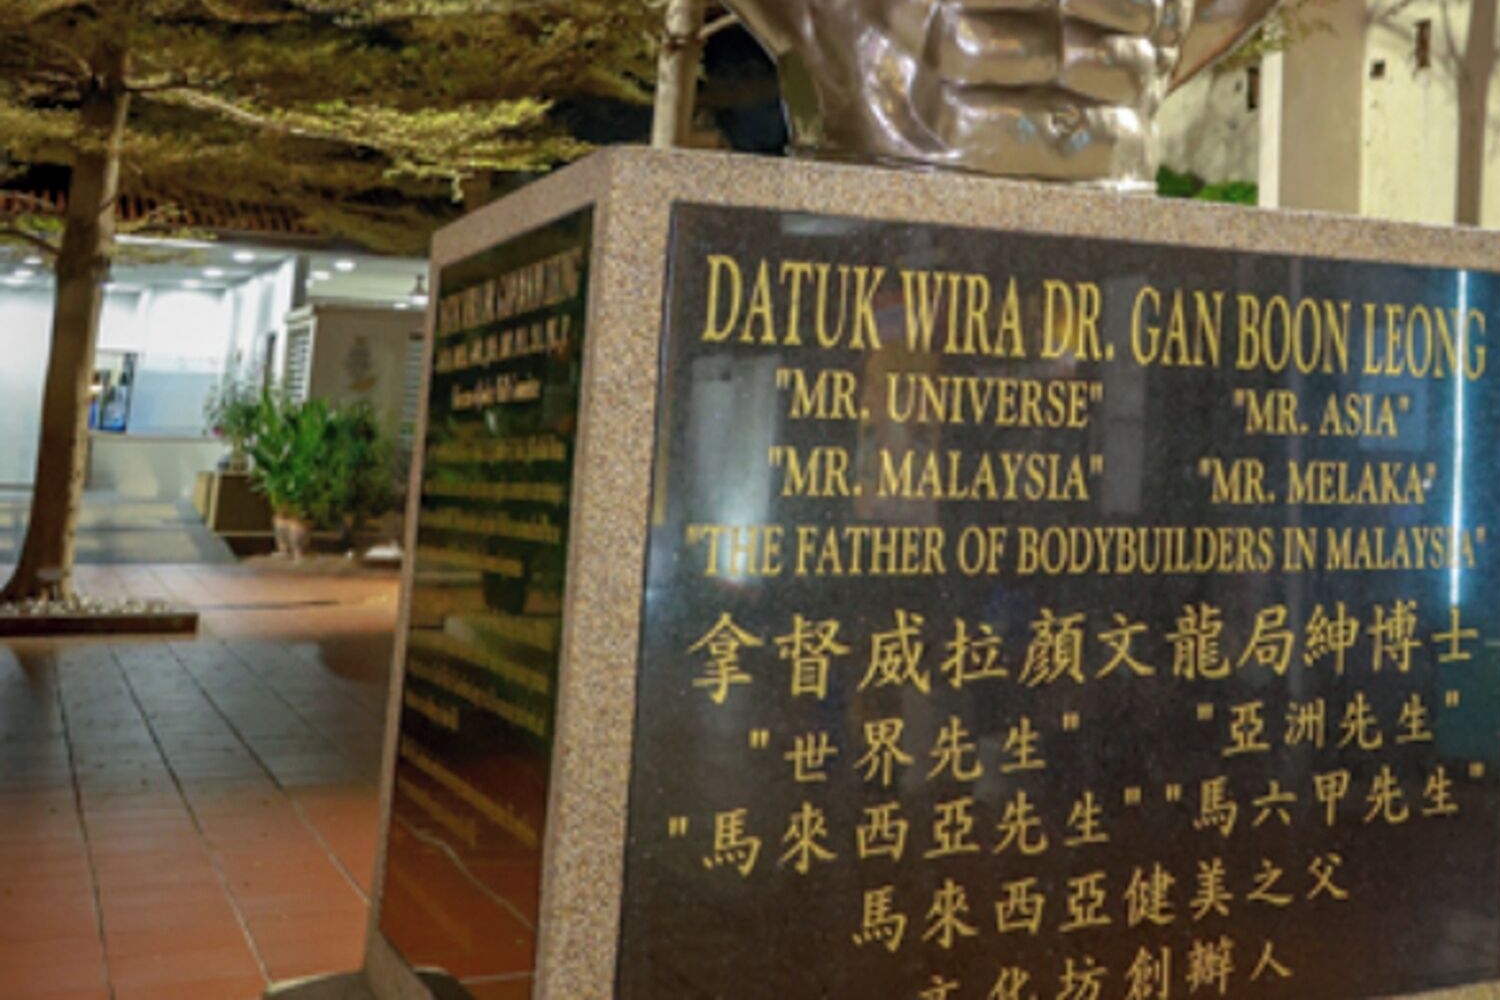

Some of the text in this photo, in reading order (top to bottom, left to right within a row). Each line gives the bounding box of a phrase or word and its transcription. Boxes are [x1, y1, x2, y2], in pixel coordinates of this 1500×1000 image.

[701, 254, 1487, 381] DATUK WIRA DR. GAN BOON LEONG
[775, 367, 1103, 428] "MR. UNIVERSE"
[1233, 388, 1409, 437] "MR. ASIA"
[768, 445, 1103, 500] "MR. MALAYSIA"
[1200, 457, 1436, 505] "MR. MELAKA"
[685, 524, 1487, 576] "THE FATHER OF BODYBUILDERS IN MALAYSIA"
[851, 851, 1351, 952] 馬來西亞健美之父
